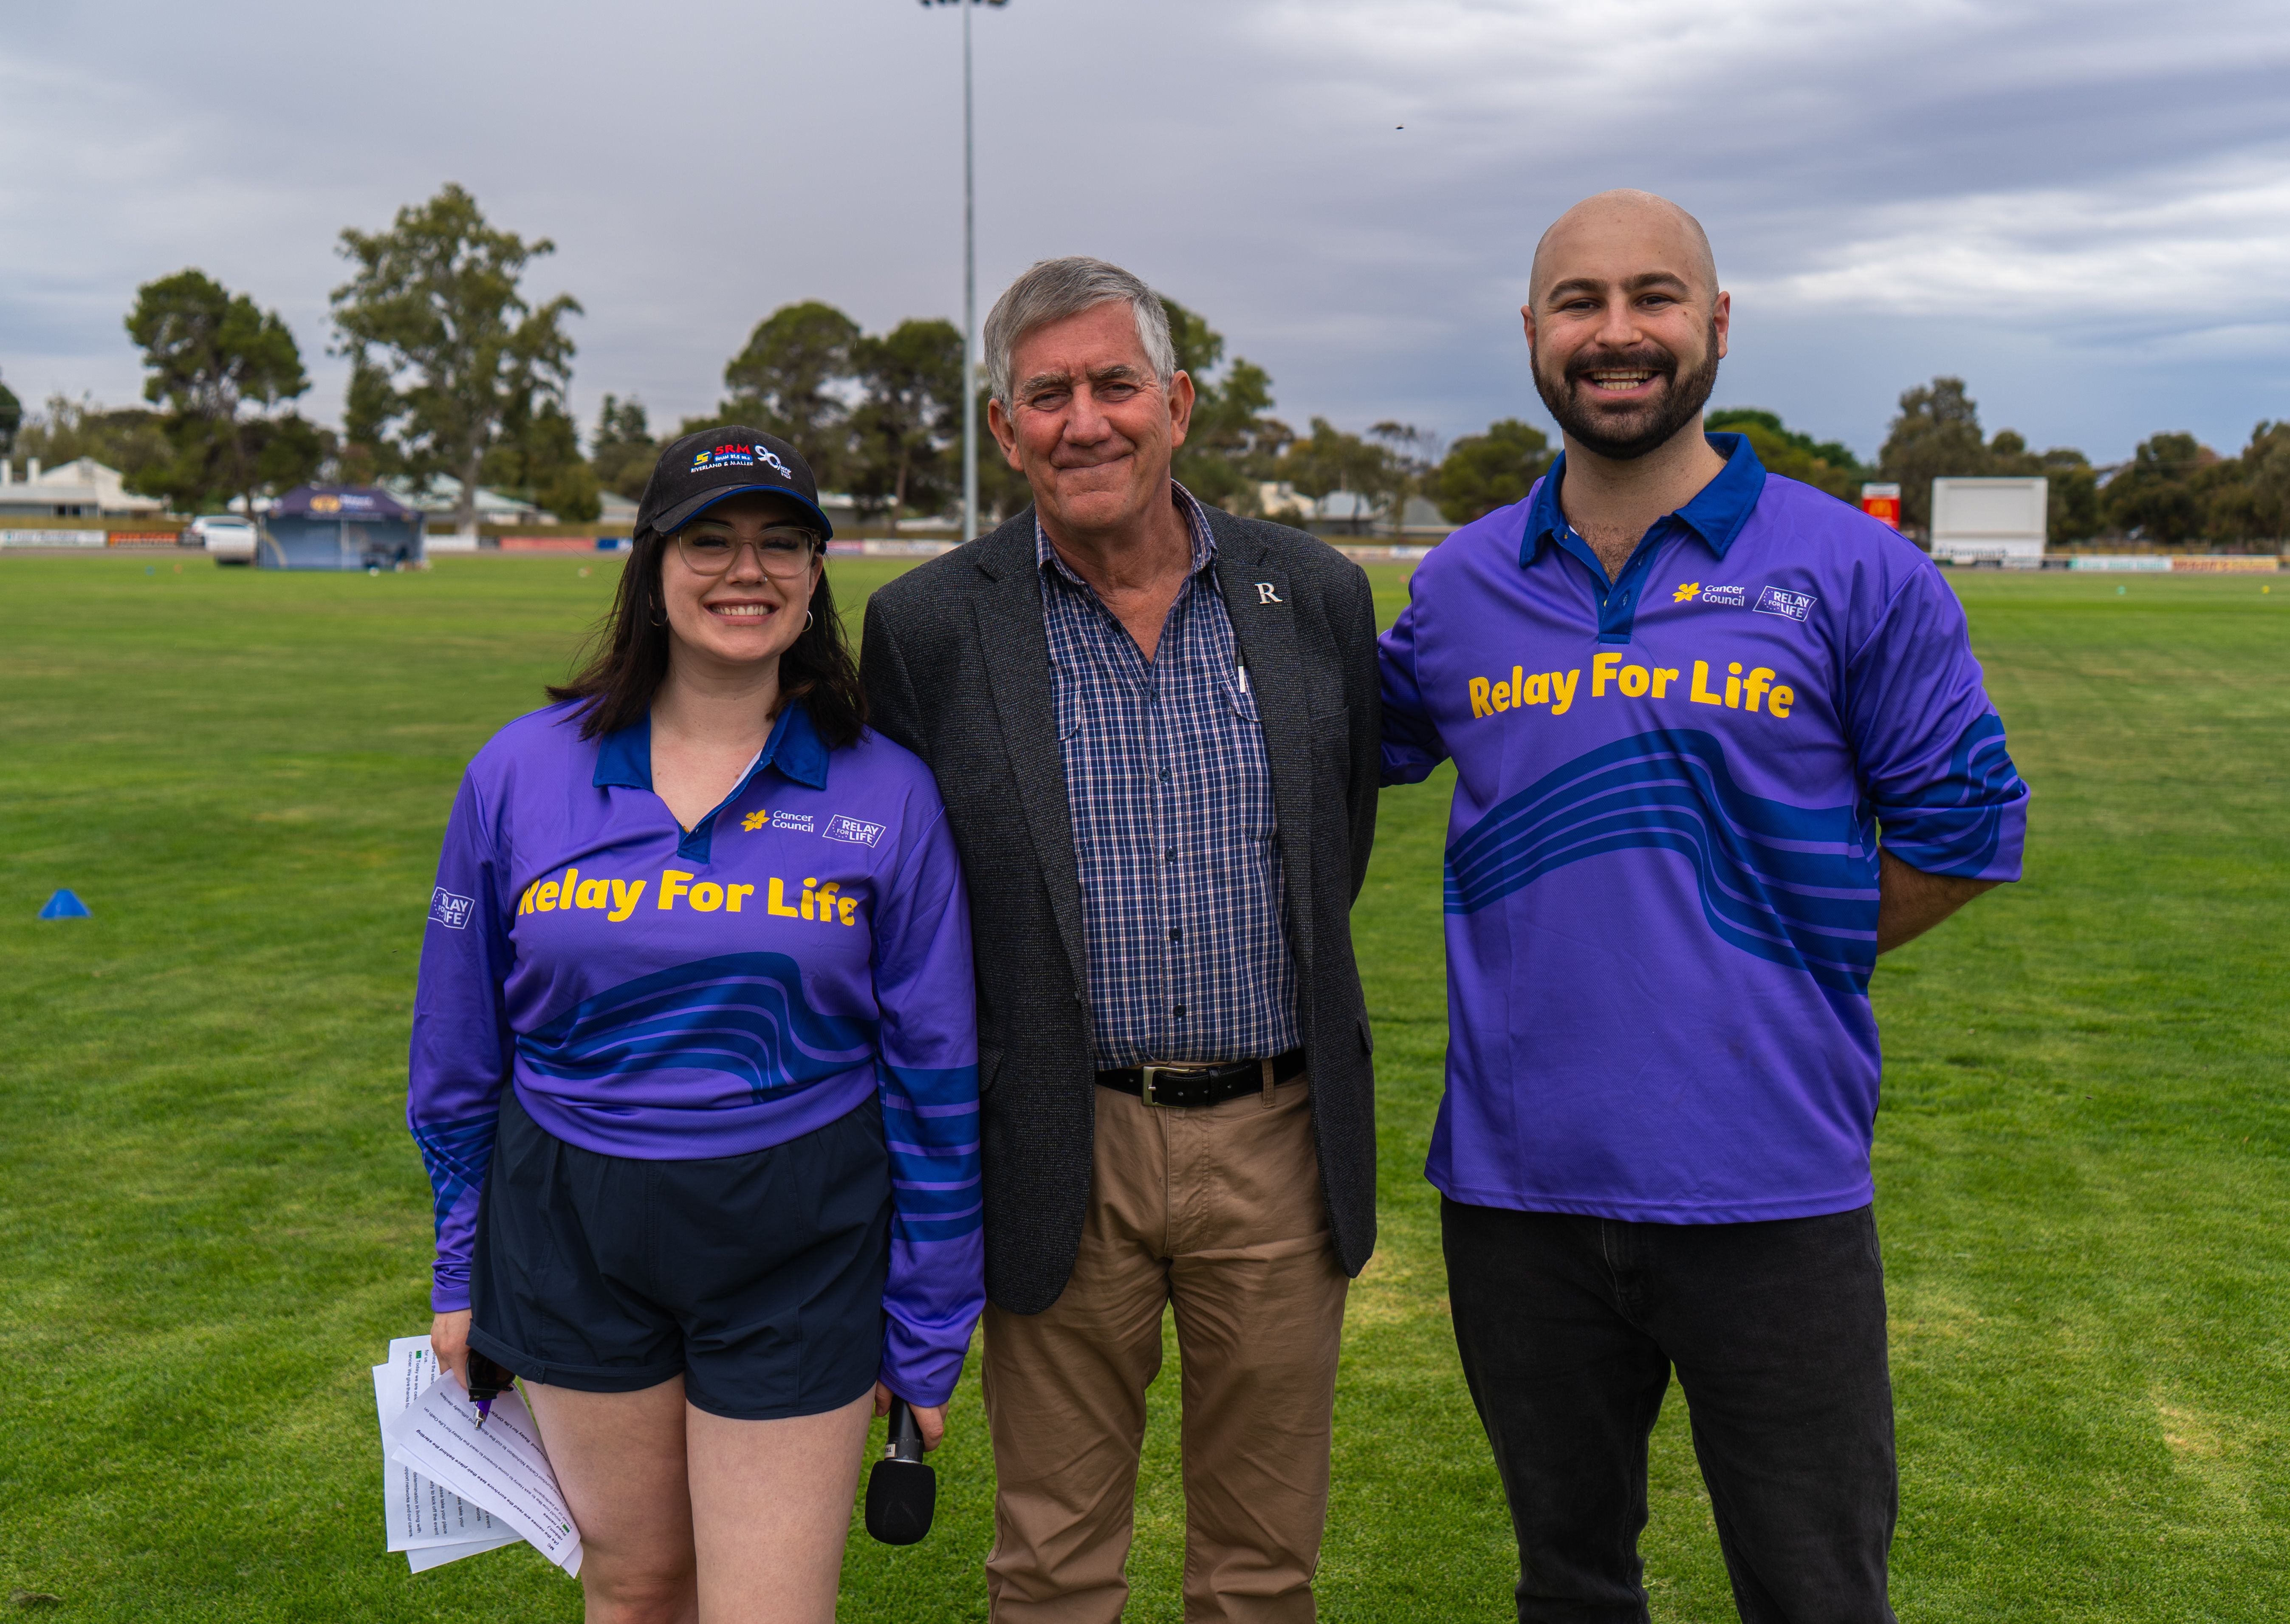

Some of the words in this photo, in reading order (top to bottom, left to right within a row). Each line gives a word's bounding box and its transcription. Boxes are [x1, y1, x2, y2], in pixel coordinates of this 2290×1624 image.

[715, 443, 751, 455] 5RM
[690, 463, 722, 473] RIVERLAND
[1254, 582, 1282, 604] R
[1705, 585, 1745, 594] Cancer
[1702, 592, 1745, 606] Council
[1774, 591, 1809, 607] RELAY
[1781, 605, 1804, 618] LIFE
[1469, 665, 1580, 719] Relay
[1593, 652, 1679, 698] For
[1690, 660, 1794, 718] Life
[773, 810, 813, 822] Cancer
[772, 819, 814, 833] Council
[842, 819, 879, 835] RELAY
[849, 831, 873, 844] LIFE
[518, 868, 647, 922] Relay
[658, 870, 754, 913] For
[768, 877, 856, 926] Life
[440, 1392, 453, 1406] declare
[429, 1412, 438, 1421] Oath
[453, 1405, 469, 1418] officially
[416, 1429, 432, 1443] starting
[451, 1431, 463, 1440] Relay
[518, 1432, 530, 1443] Relay
[438, 1448, 455, 1460] behind
[469, 1444, 479, 1452] read
[483, 1455, 498, 1468] forward
[506, 1449, 526, 1466] Nicholson
[455, 1459, 468, 1469] place
[467, 1468, 477, 1476] their
[498, 1466, 509, 1476] come
[525, 1464, 538, 1477] Carina
[513, 1479, 524, 1489] Harry
[537, 1475, 555, 1489] Survivor
[487, 1483, 506, 1499] survivors
[513, 1505, 524, 1513] read
[542, 1503, 551, 1511] now
[543, 1513, 556, 1525] names
[549, 1511, 561, 1522] would
[531, 1519, 545, 1531] names
[556, 1525, 568, 1536] Read
